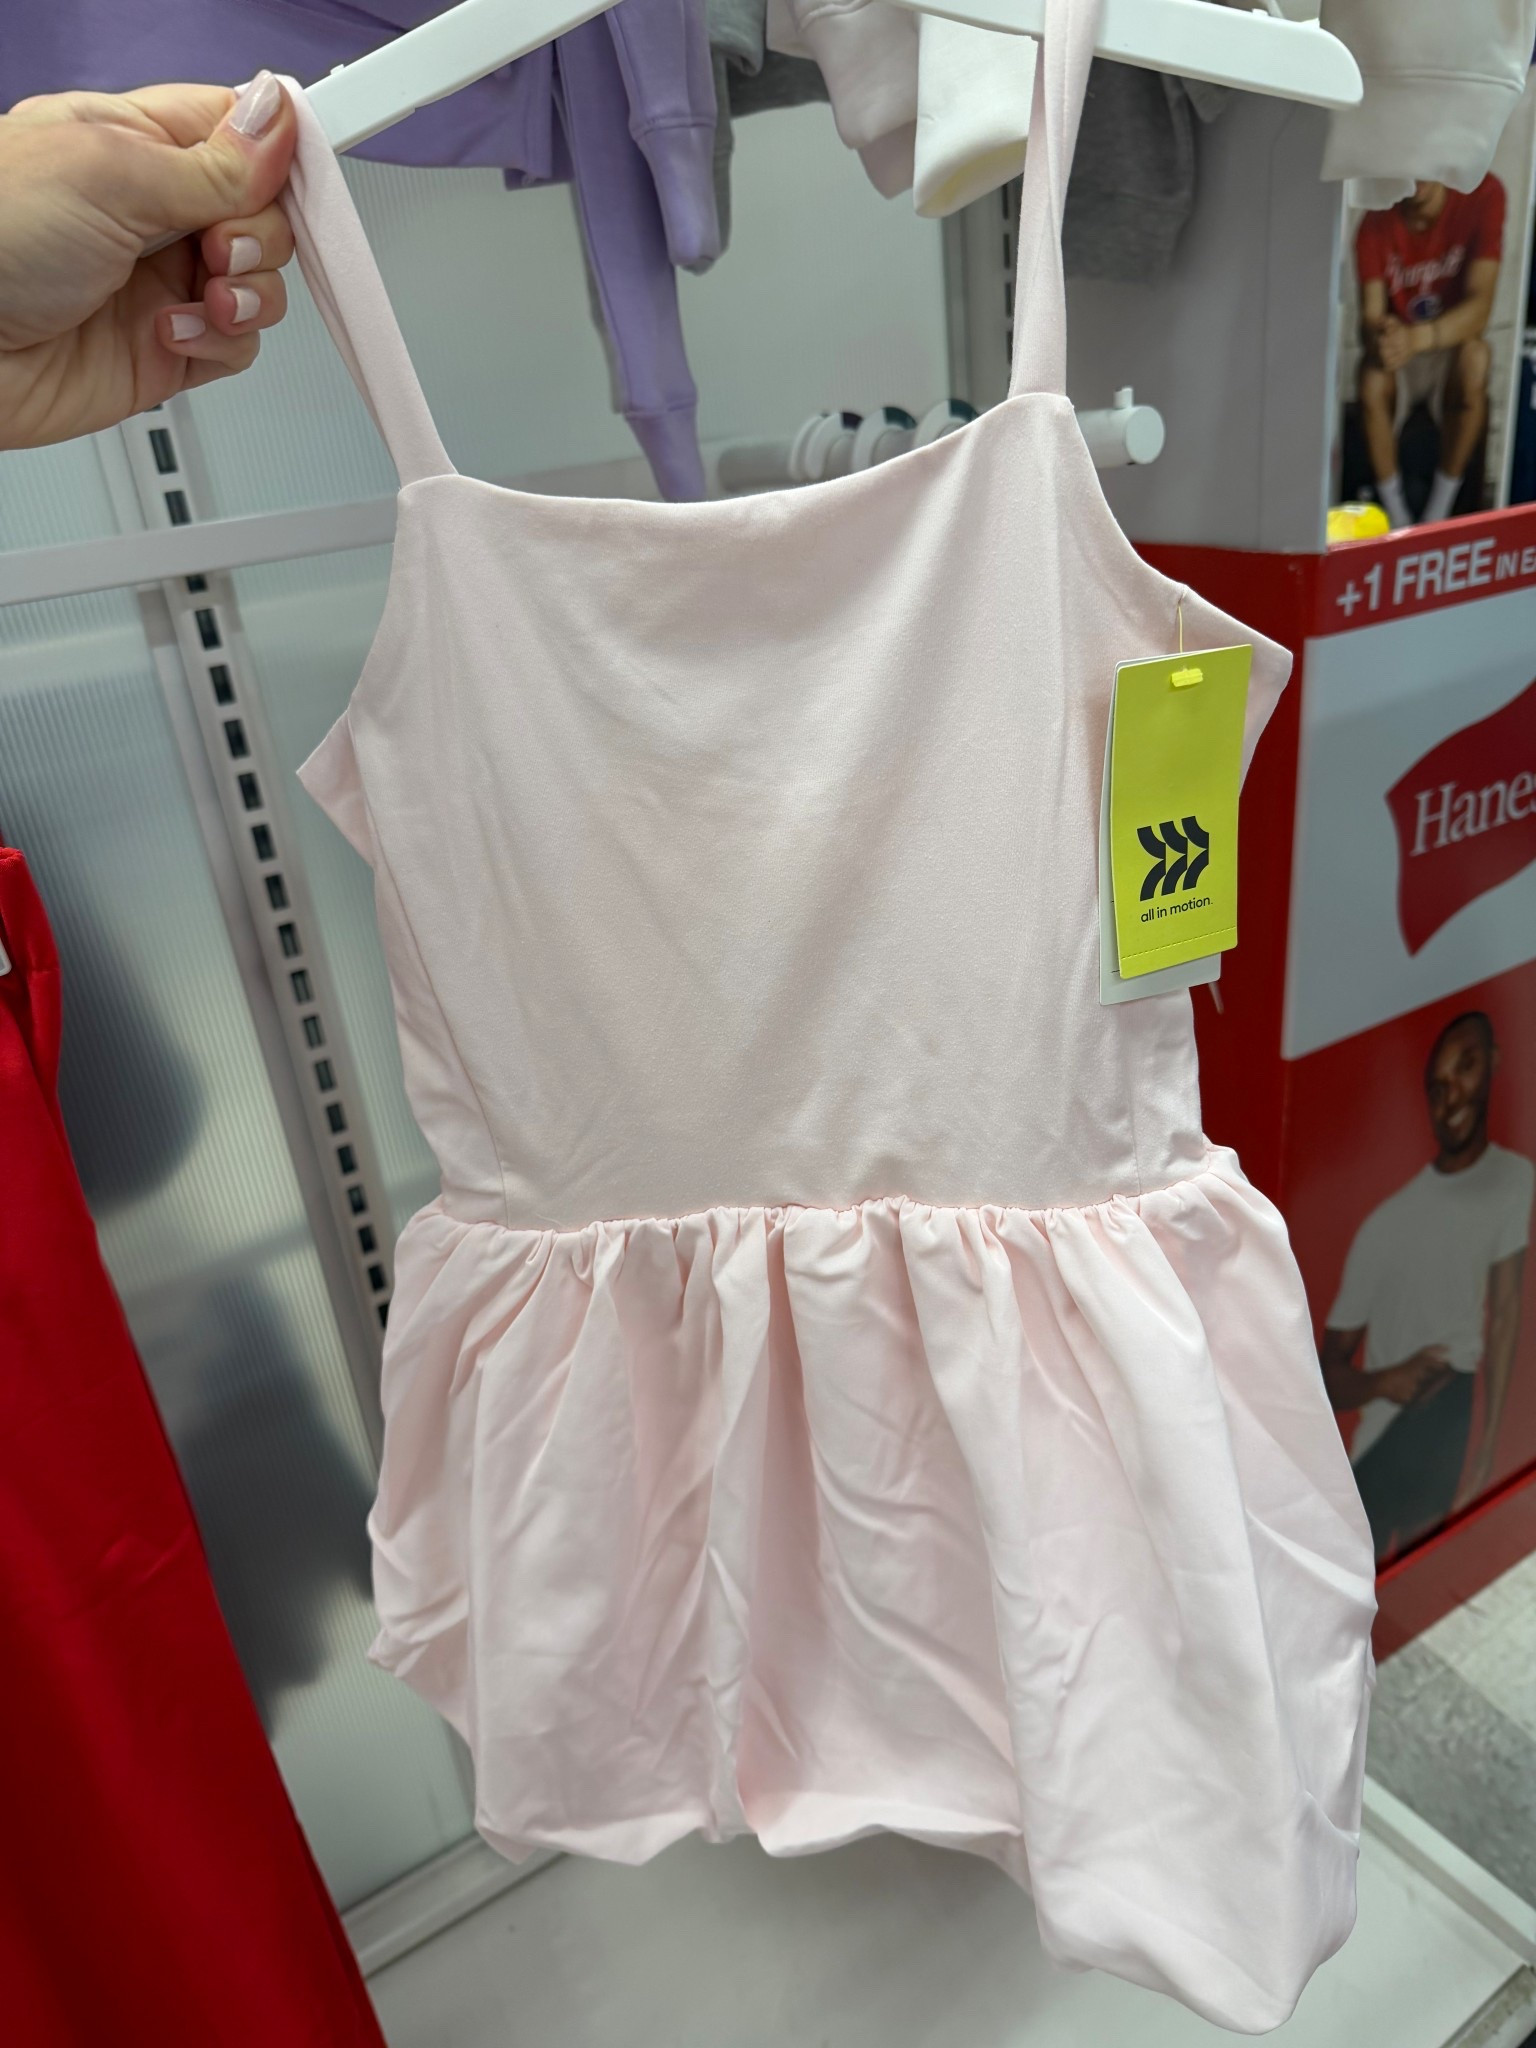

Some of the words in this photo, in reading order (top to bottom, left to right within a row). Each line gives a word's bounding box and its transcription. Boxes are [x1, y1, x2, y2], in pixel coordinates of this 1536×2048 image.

[1336, 563, 1383, 616] +1
[1393, 538, 1495, 604] FREE
[1496, 551, 1519, 580] IN
[1410, 772, 1536, 856] Hane
[1141, 909, 1154, 922] all
[1157, 907, 1167, 918] in
